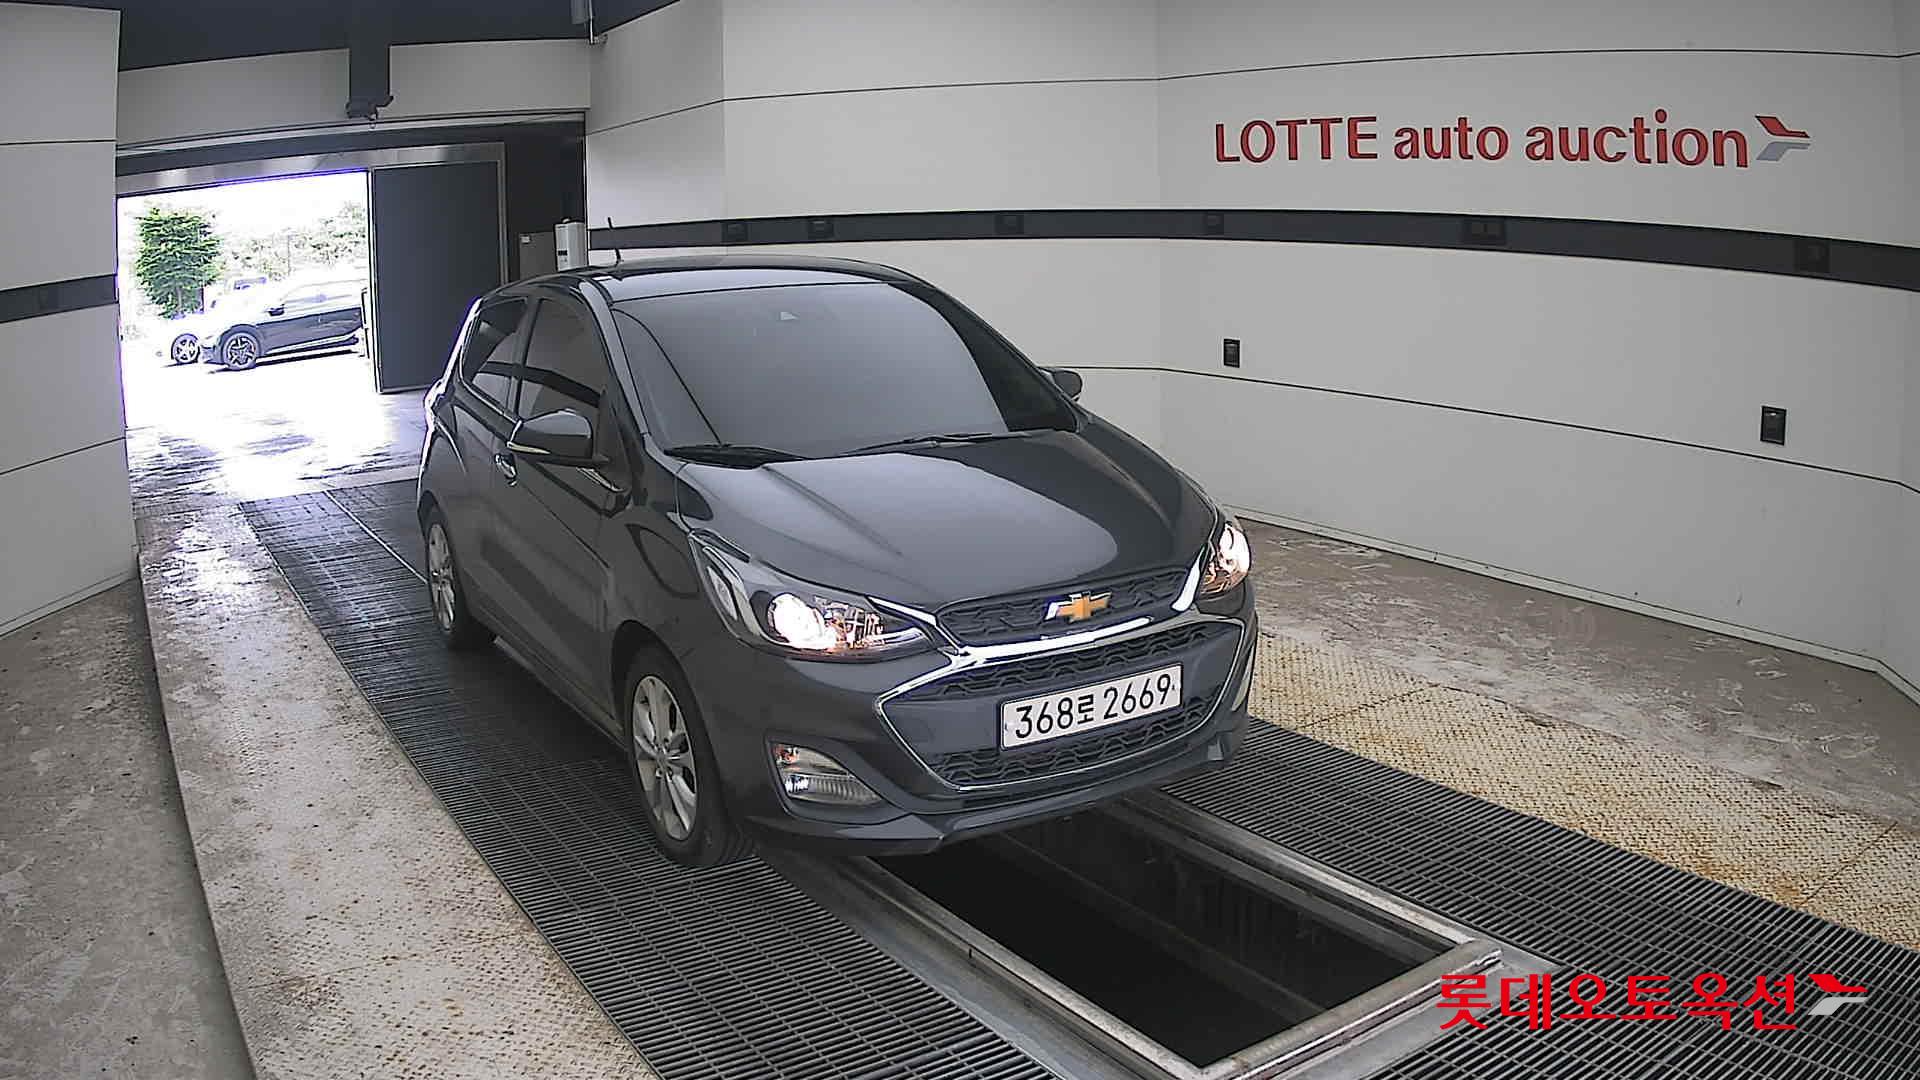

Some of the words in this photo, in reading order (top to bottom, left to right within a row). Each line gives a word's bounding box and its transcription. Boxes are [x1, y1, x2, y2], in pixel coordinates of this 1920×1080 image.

[1215, 116, 1378, 163] LOTTE
[1394, 117, 1509, 160] auto
[1525, 108, 1750, 168] auction
[1015, 694, 1094, 739] 368로
[1103, 673, 1171, 720] 2669
